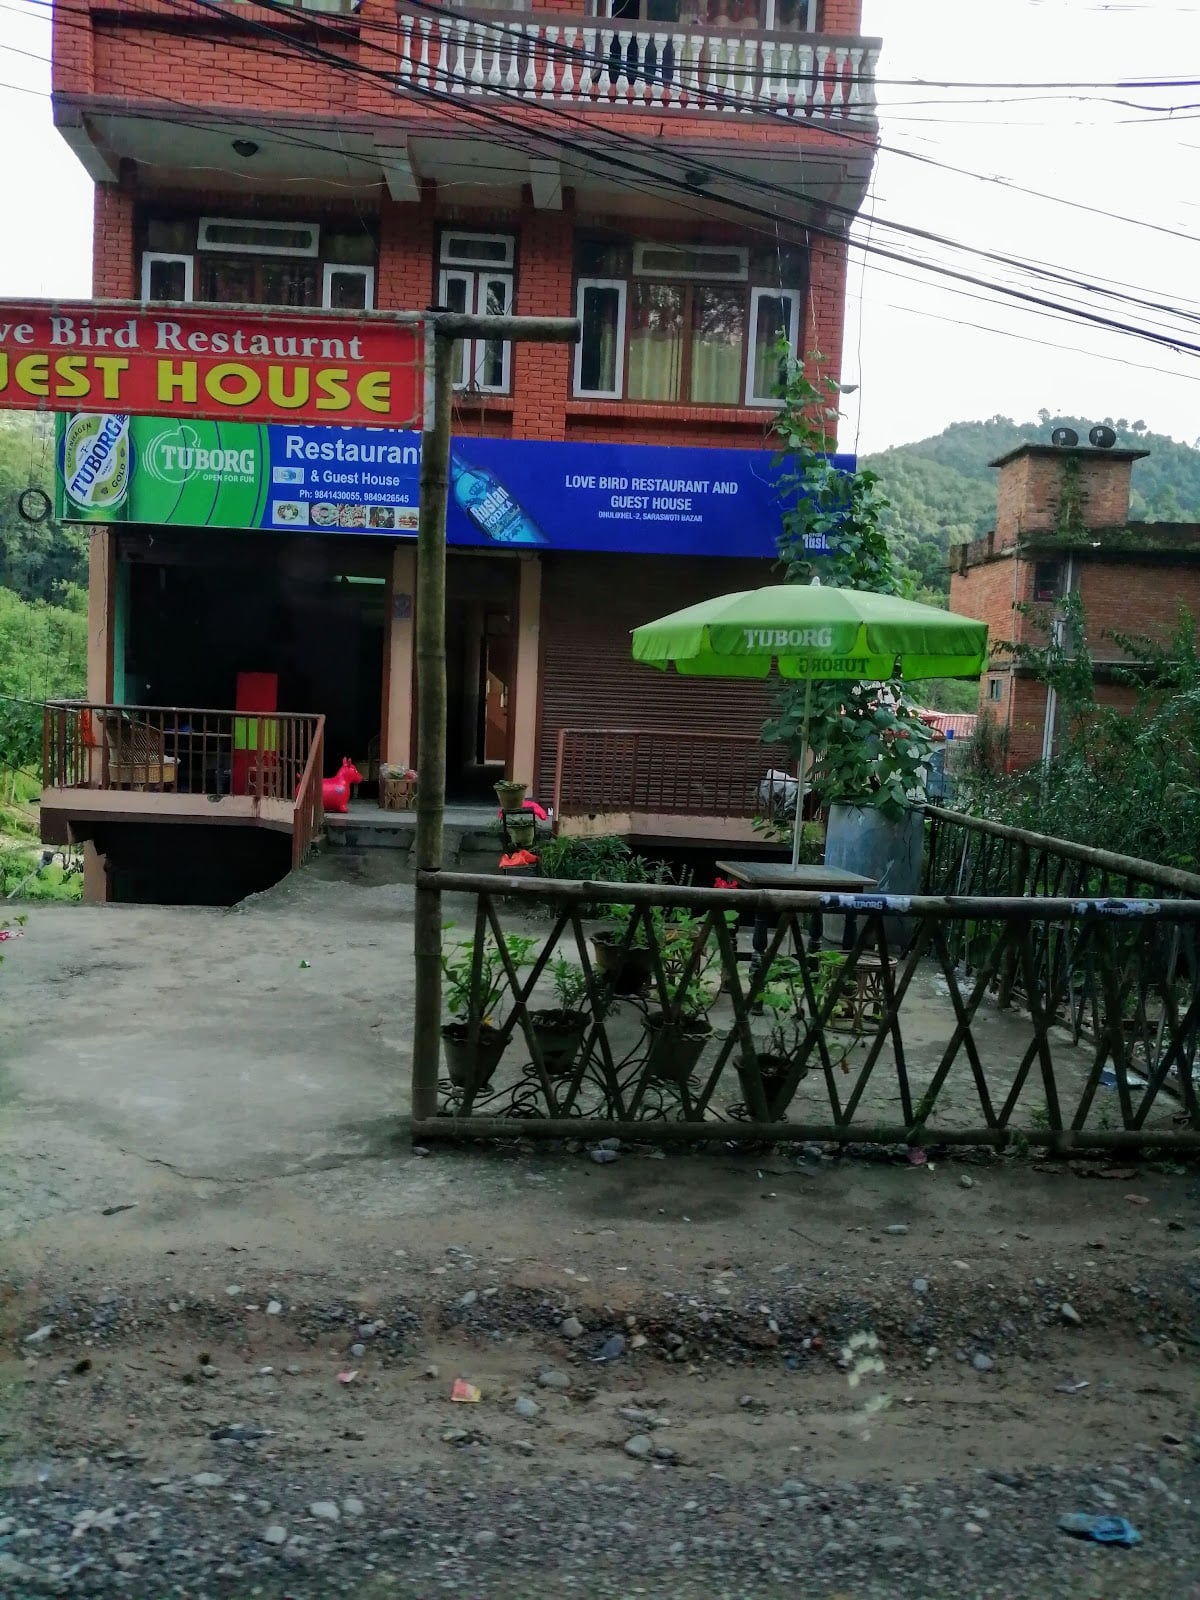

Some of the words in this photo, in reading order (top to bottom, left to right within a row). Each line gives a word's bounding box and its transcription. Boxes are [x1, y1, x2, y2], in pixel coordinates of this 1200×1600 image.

[49, 316, 140, 348] Bird
[154, 321, 365, 360] Restaurnt
[0, 352, 129, 399] EST
[158, 359, 391, 413] HOUSE
[71, 417, 123, 497] TUBORG
[161, 444, 255, 475] TUBORG
[111, 463, 126, 489] GOLD
[202, 473, 222, 481] OPEN
[224, 474, 239, 483] FOR
[240, 475, 255, 484] FUN
[310, 469, 320, 483] &
[323, 470, 359, 485] Guest
[361, 472, 400, 487] House
[565, 475, 597, 489] LOVE
[599, 477, 629, 490] BIRD
[631, 478, 710, 494] RESTAURANT
[712, 481, 738, 495] AND
[299, 489, 313, 499] Ph:
[610, 495, 650, 510] GUEST
[652, 497, 692, 511] HOUSE
[483, 500, 514, 528] VODKA
[743, 627, 833, 649] TUBORG
